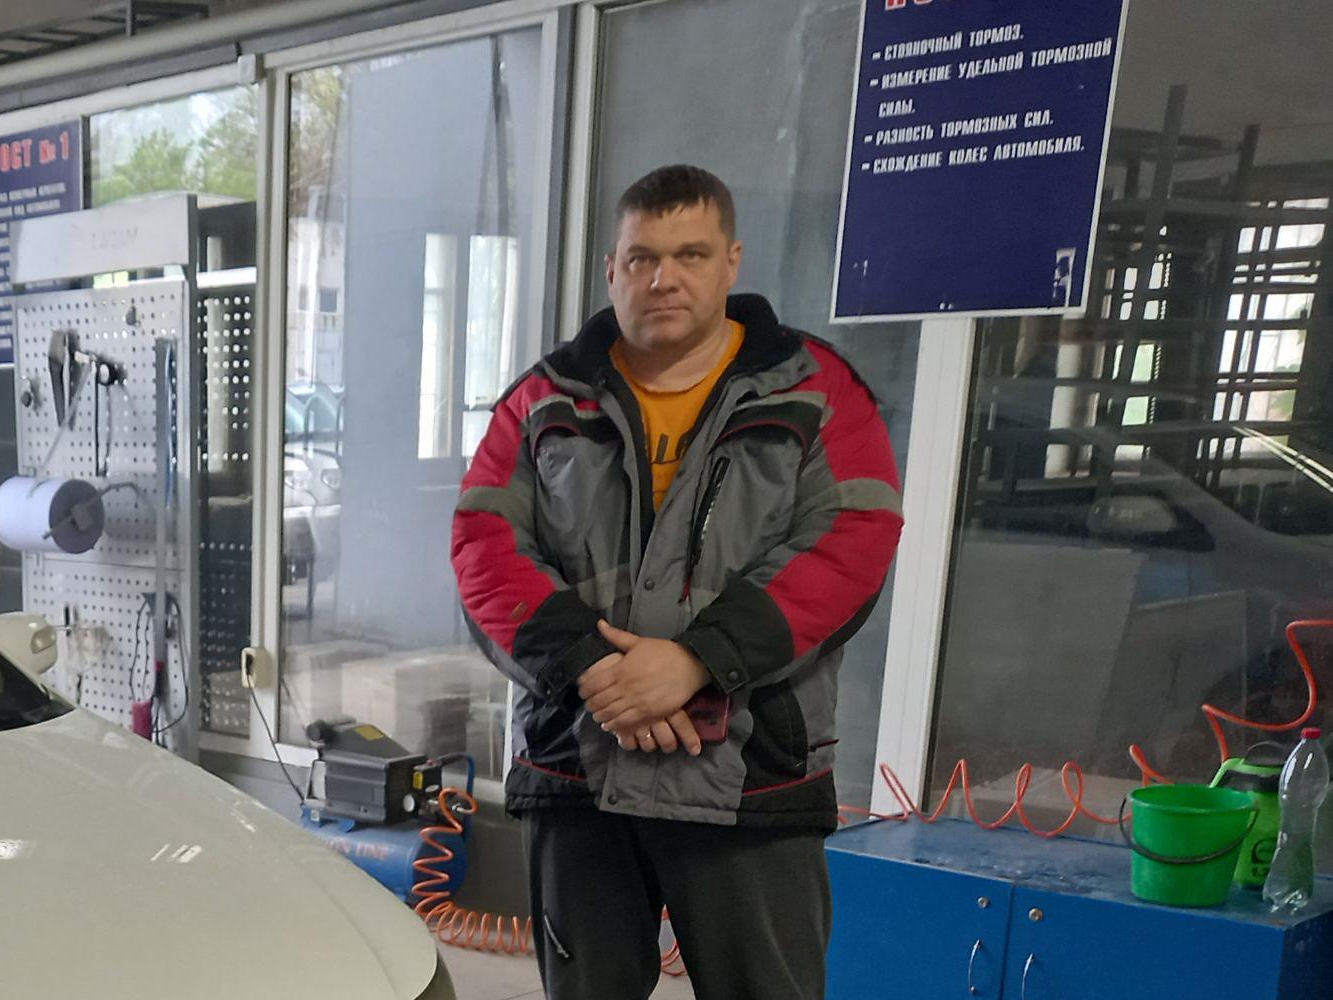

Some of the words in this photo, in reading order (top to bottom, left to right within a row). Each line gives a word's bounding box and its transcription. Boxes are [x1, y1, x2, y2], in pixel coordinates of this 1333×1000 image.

[884, 31, 963, 61] СТОЯНОЧНЫЙ
[969, 24, 1024, 48] ТОРМОЗ.
[881, 64, 952, 90] ИЗМЕРЕНИЕ
[958, 52, 1024, 79] УДЕЛЬНОЙ
[1031, 37, 1112, 67] ТОРМОЗНОЙ
[878, 98, 915, 118] СИЛЫ.
[875, 125, 934, 147] РАЗНОСТЬ
[940, 113, 1018, 138] ТОРМОЗНЫХ
[1024, 109, 1054, 128] СИЛ.
[872, 151, 943, 174] СХОЖДЕНИЕ
[948, 146, 988, 166] КОЛЕС
[993, 136, 1085, 161] АВТОМОБИЛЯ.
